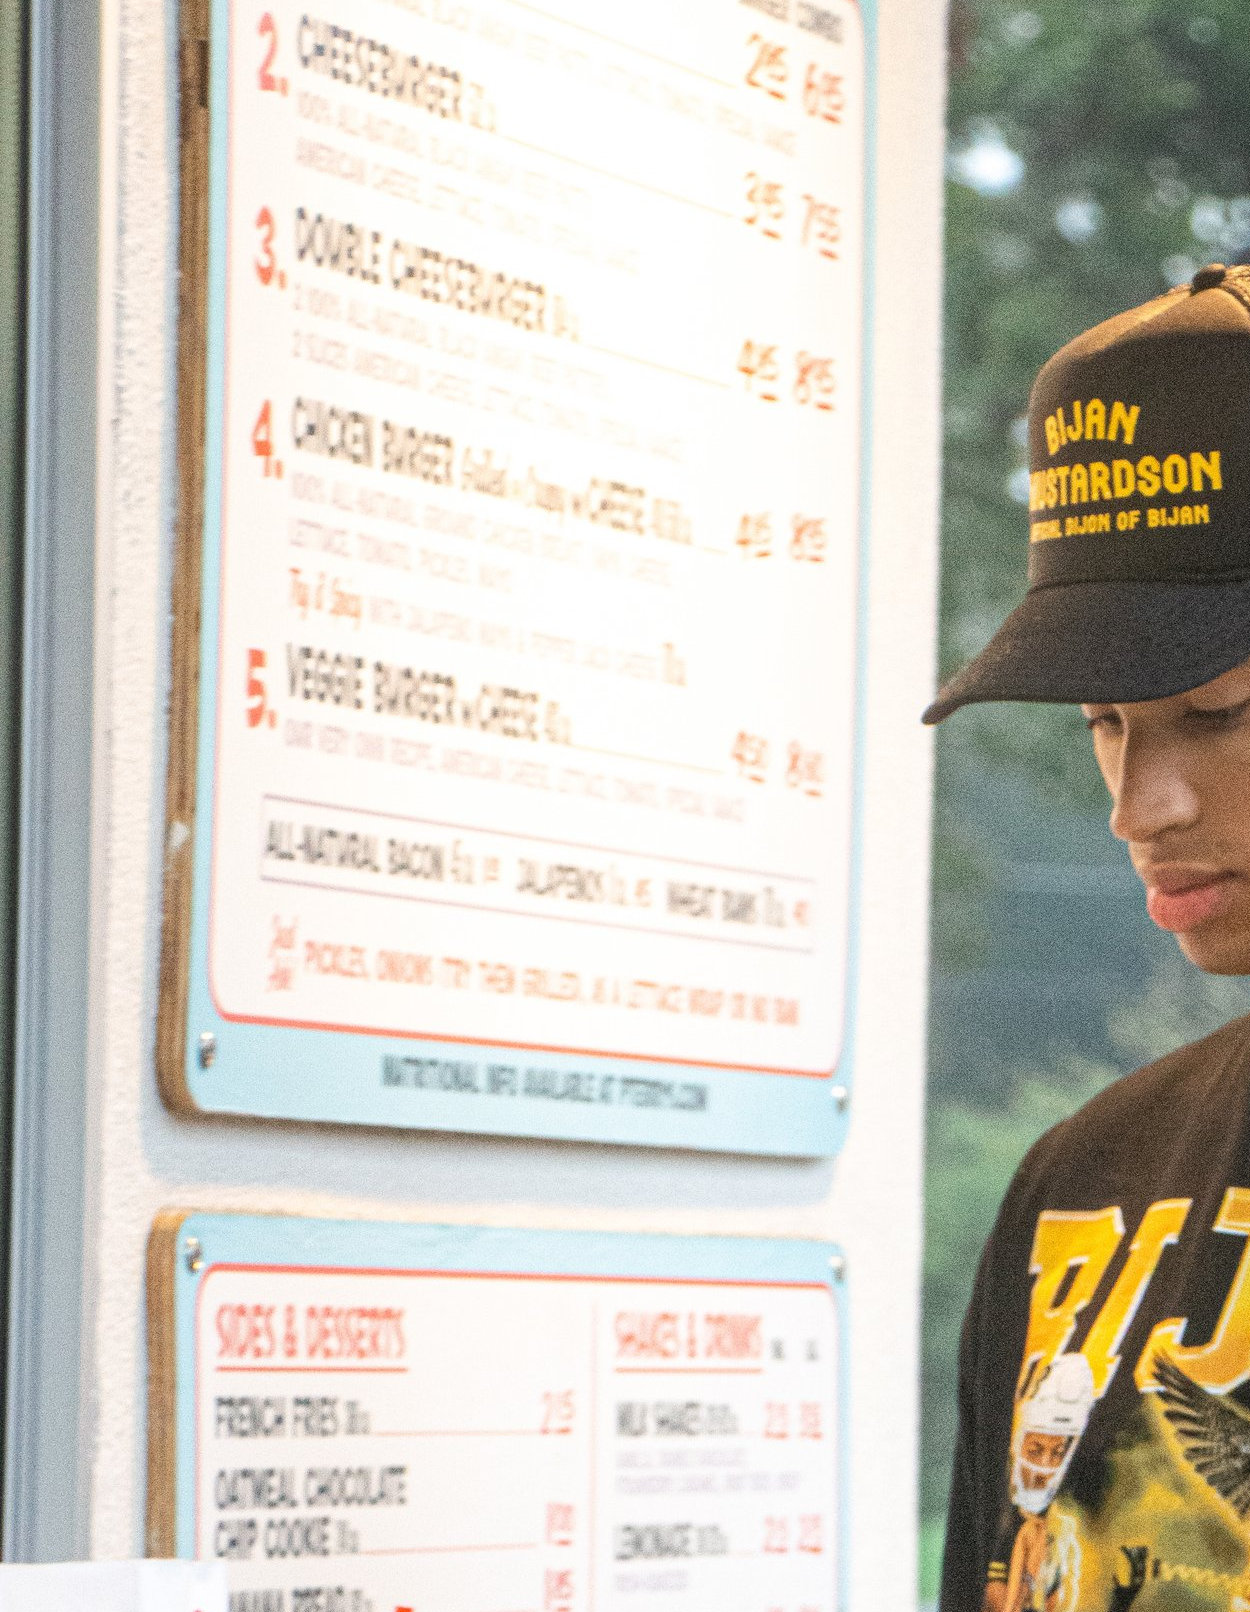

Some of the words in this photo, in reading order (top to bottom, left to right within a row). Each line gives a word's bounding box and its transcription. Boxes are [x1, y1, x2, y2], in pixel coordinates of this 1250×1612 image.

[256, 10, 289, 97] 2.
[296, 13, 463, 122] CHEESEBURGER
[254, 204, 287, 292] 3.
[295, 205, 383, 287] DOUBLE
[389, 237, 546, 334] CHEESEBURGER
[251, 397, 284, 480] 4.
[291, 395, 374, 469] CHICKEN
[381, 418, 455, 487] BURGER
[1044, 397, 1141, 456] BIJAN
[1116, 510, 1141, 532] OF
[1147, 503, 1211, 529] BIJAN
[245, 647, 277, 729] 5.
[284, 642, 364, 711] VEGGIE
[372, 659, 456, 727] BURGER
[262, 818, 381, 874] ALL-NATURAL
[387, 836, 445, 882] BACON
[213, 1302, 277, 1359] SIDES
[305, 1306, 406, 1359] DESSERTS
[214, 1395, 286, 1439] FRENCH
[291, 1395, 340, 1438] FRIES
[214, 1466, 299, 1512] OATMEAL
[304, 1464, 408, 1507] CHOCOLATE
[213, 1518, 258, 1561] CHIP
[263, 1515, 331, 1560] COOKIE
